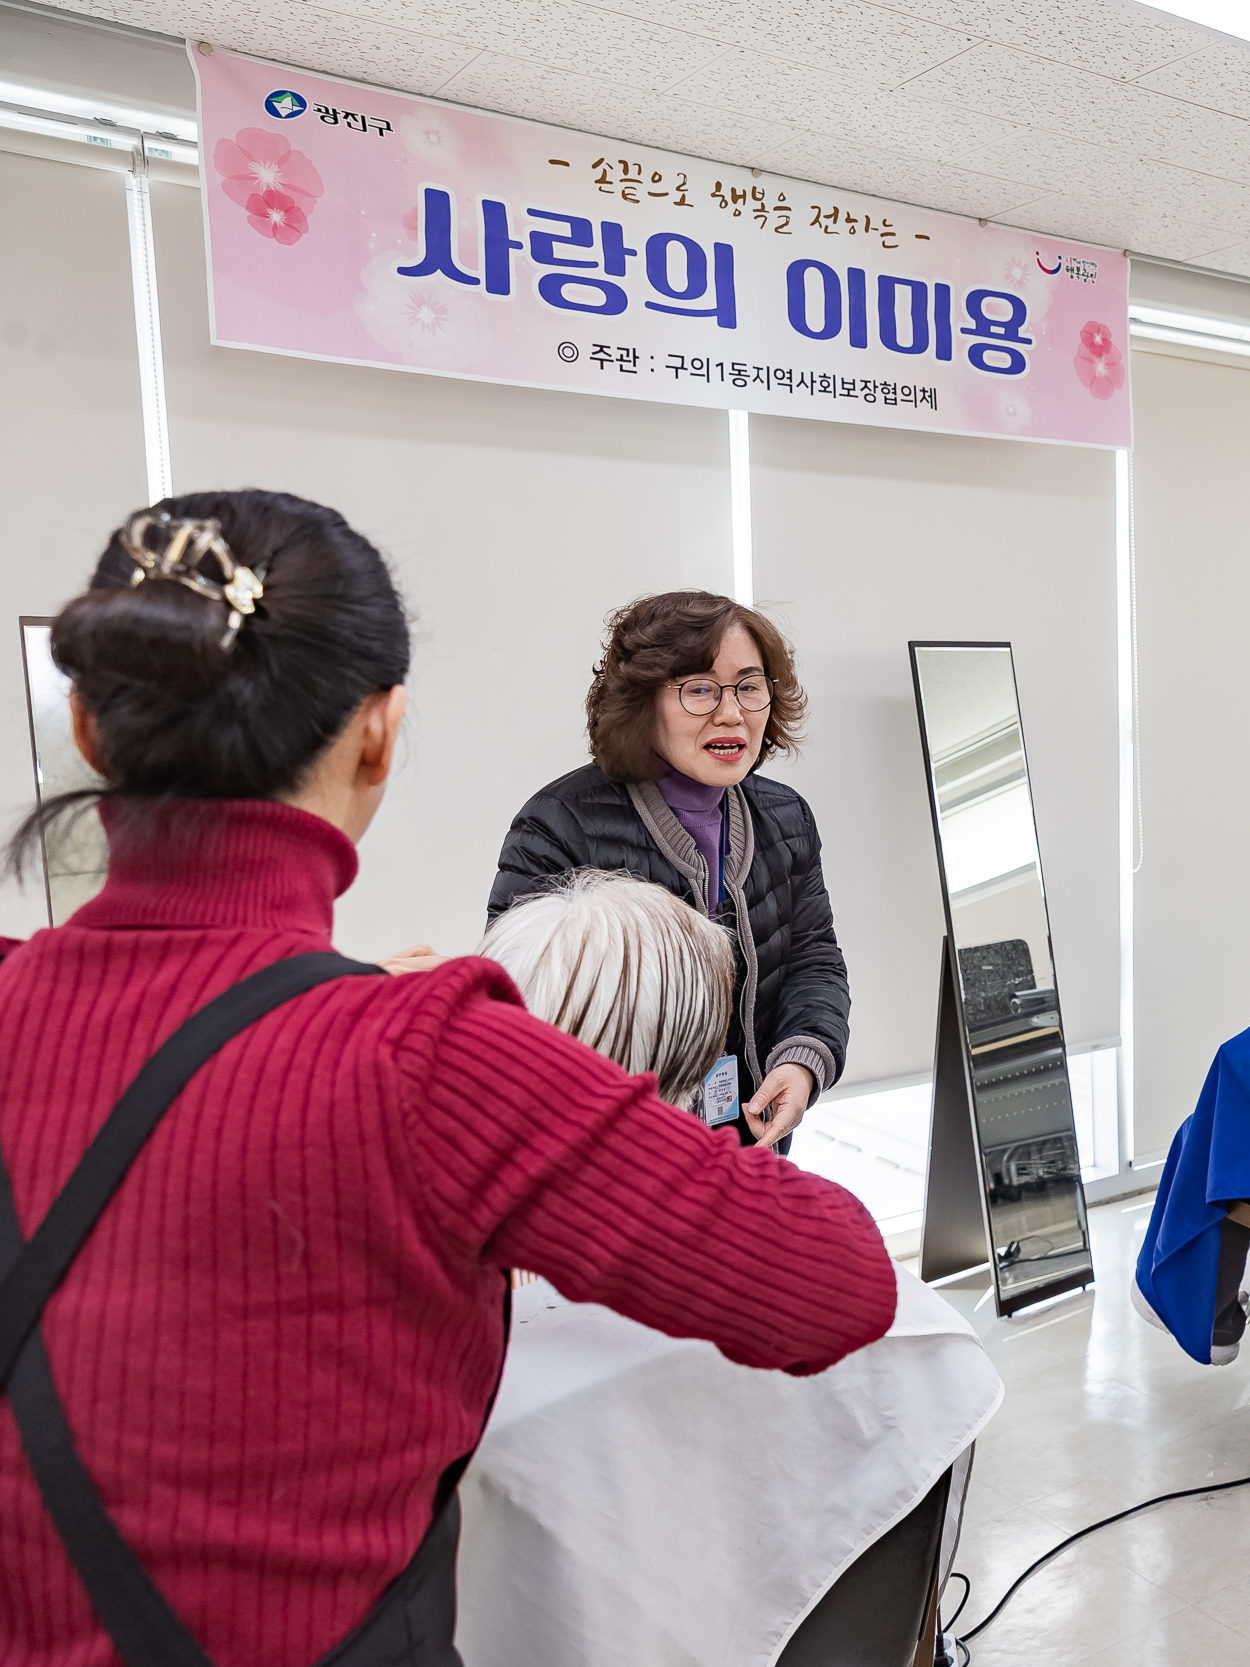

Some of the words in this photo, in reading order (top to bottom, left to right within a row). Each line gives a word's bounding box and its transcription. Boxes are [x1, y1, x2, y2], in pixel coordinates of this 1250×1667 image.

[312, 102, 394, 138] 광진구
[592, 156, 694, 208] 손끝으로
[711, 180, 793, 235] 행복을
[810, 205, 900, 250] 전하는
[397, 187, 737, 330] 사랑의
[786, 258, 1033, 375] 이미용
[589, 342, 640, 375] 주관
[665, 353, 938, 411] 구의1동지역사회보장협의체
